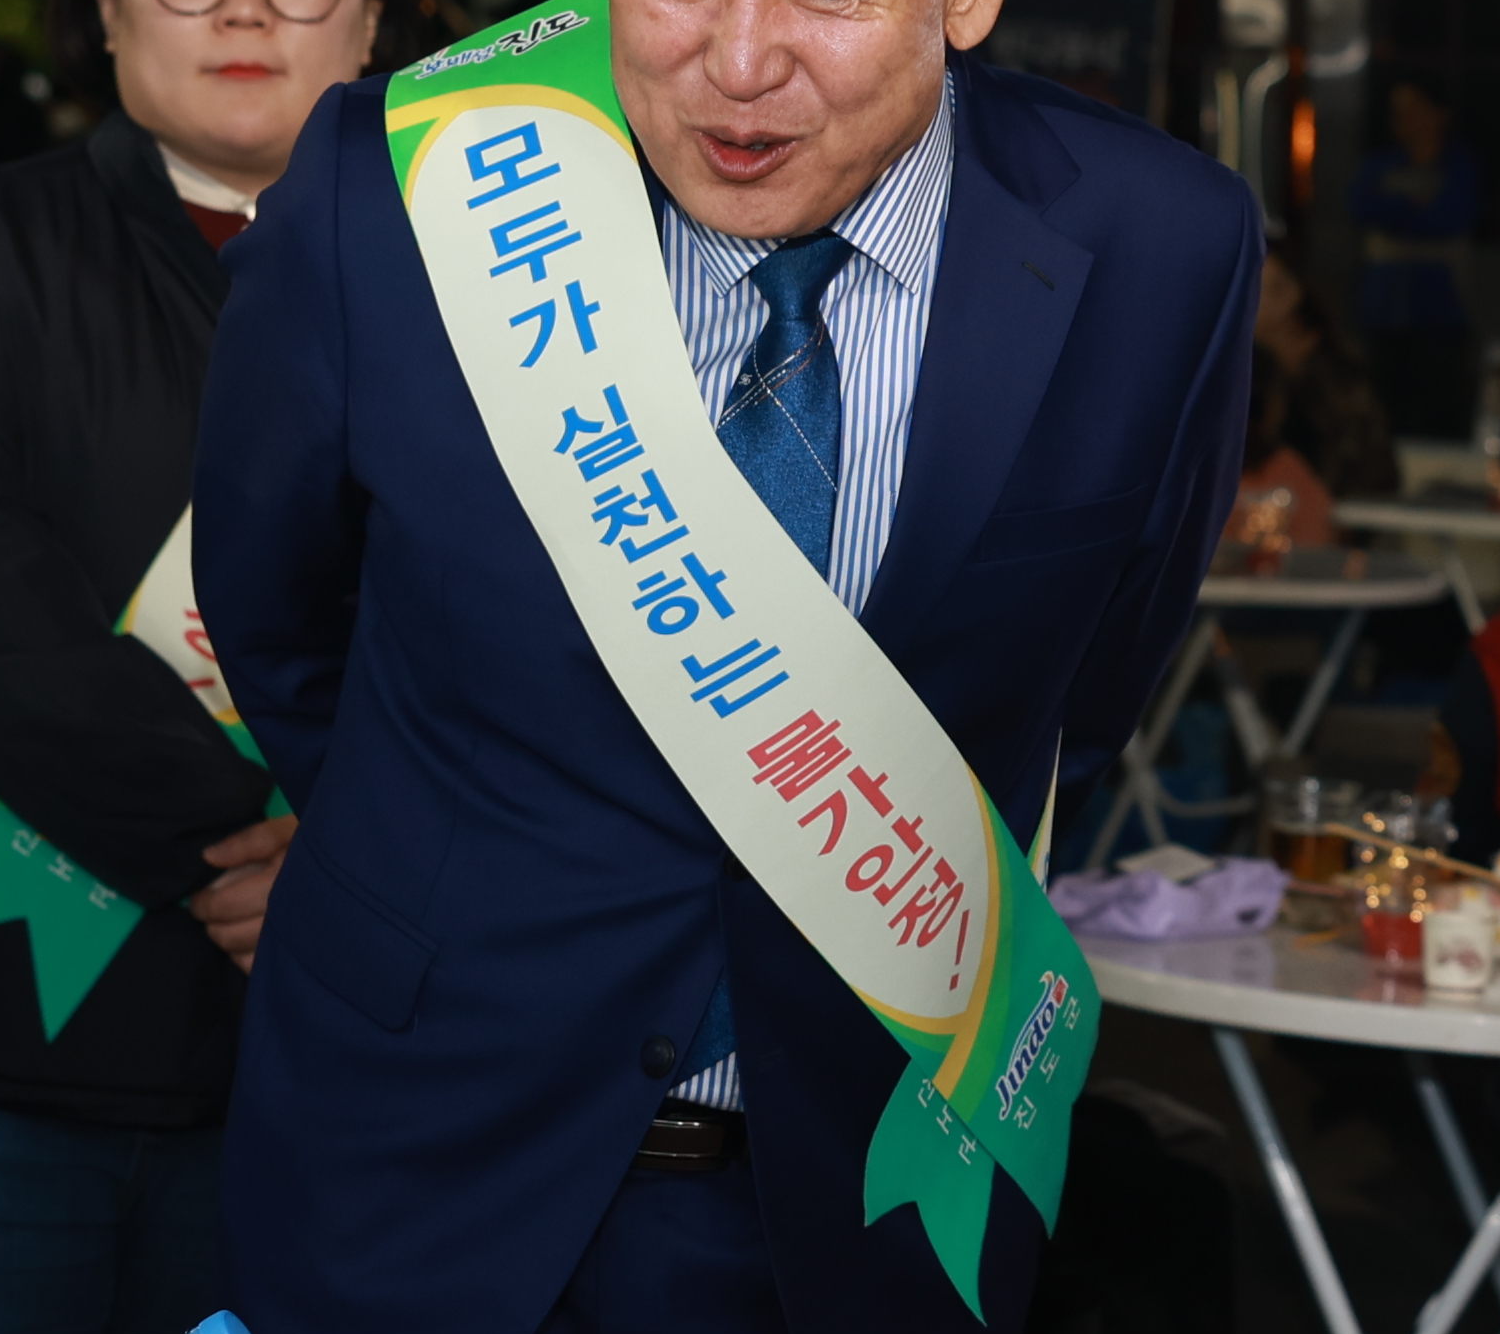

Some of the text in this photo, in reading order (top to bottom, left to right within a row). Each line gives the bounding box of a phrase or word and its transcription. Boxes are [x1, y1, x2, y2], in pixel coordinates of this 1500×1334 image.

[496, 10, 590, 56] 진도
[463, 121, 971, 992] 모두가 실천하는 물가안정!
[995, 998, 1056, 1121] Jindo
